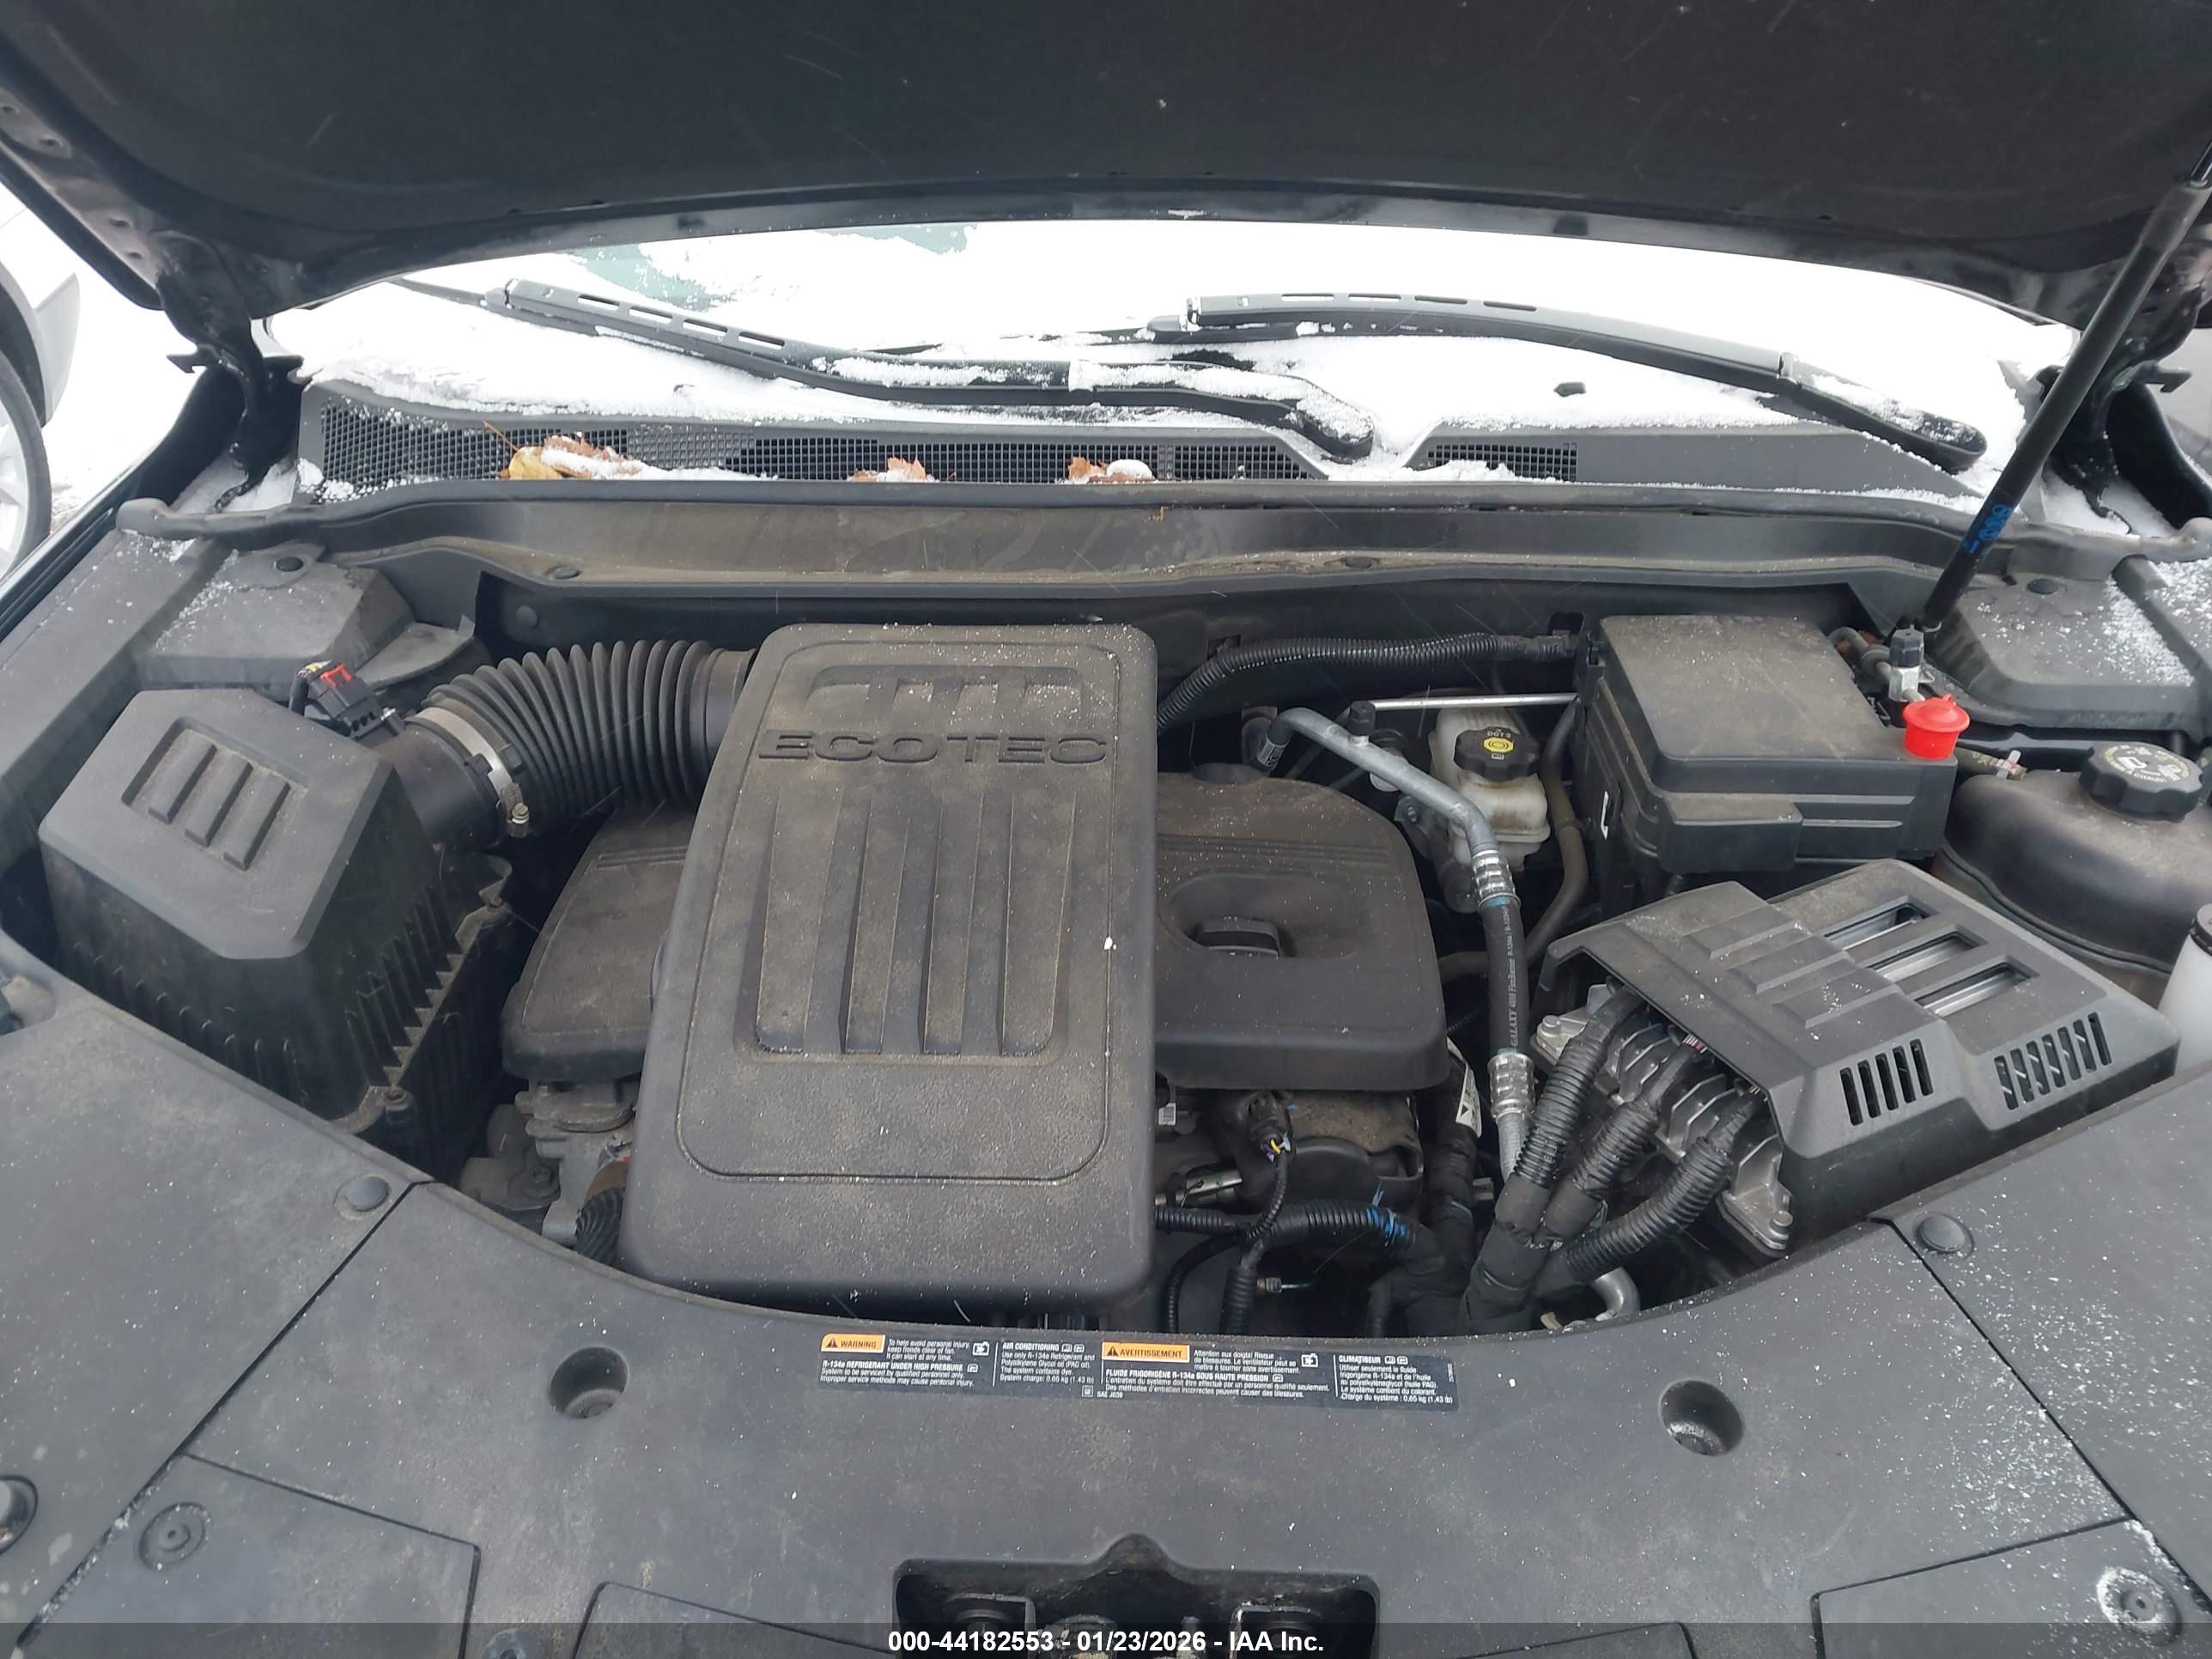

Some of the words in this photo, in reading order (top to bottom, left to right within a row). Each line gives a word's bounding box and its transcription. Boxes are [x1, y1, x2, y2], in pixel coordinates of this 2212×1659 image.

[758, 730, 1108, 764] ECOTEC
[1509, 1009, 1519, 1048] GALAXY
[1003, 1342, 1013, 1351] AIR
[1015, 1342, 1059, 1352] CONDITIONING
[1120, 1349, 1182, 1358] AVERTISSEMENT
[1255, 1352, 1274, 1360] Risque
[1001, 1358, 1036, 1367] Polyalkylene
[1339, 1355, 1381, 1364] CLIMATISEUR
[846, 1360, 890, 1370] REFRIGERANT
[1361, 1364, 1392, 1373] seulement
[821, 1368, 842, 1376] System
[1106, 1369, 1127, 1377] FLUIDE
[1172, 1371, 1195, 1380] R-134a
[896, 1377, 909, 1386] may
[1000, 1374, 1021, 1382] System
[1023, 1375, 1045, 1383] charge:
[1106, 1376, 1137, 1385] L'entretien
[1341, 1393, 1363, 1401] Charge
[1444, 1395, 1453, 1404] lb)
